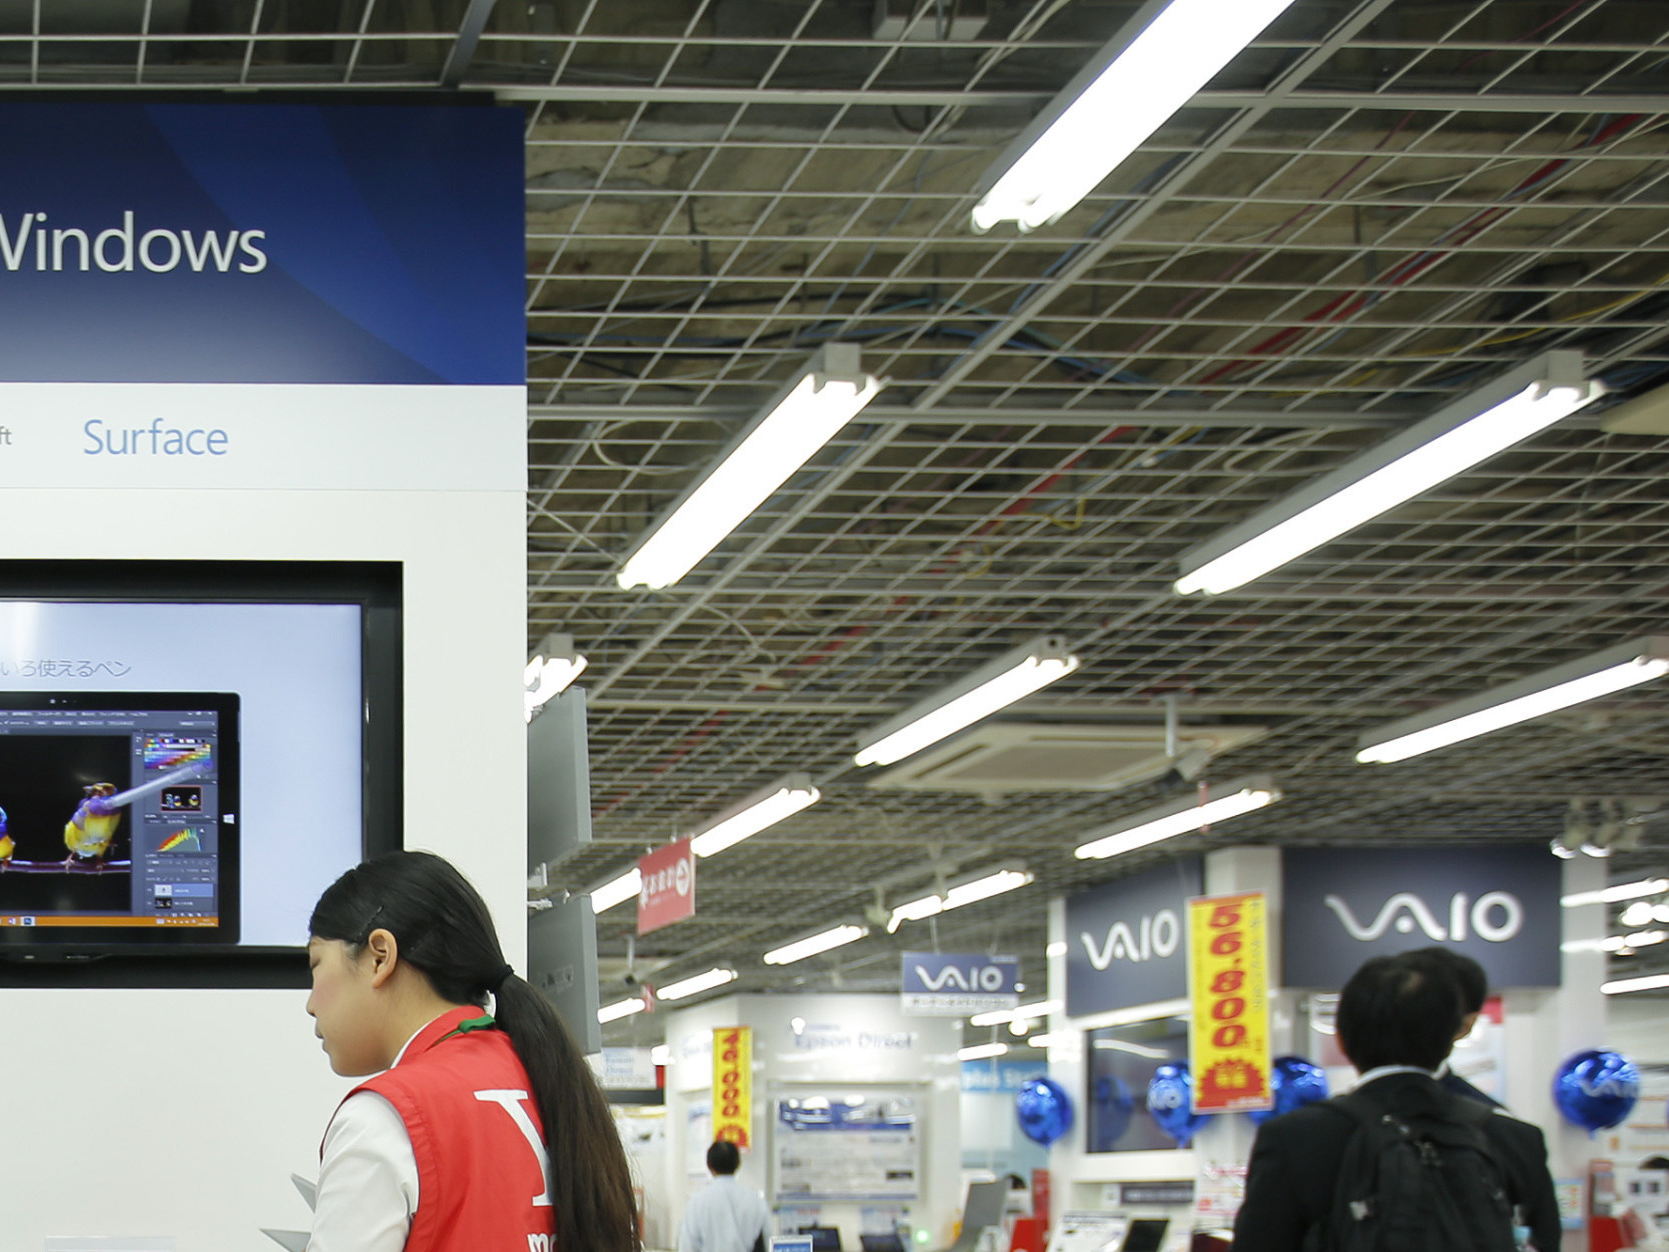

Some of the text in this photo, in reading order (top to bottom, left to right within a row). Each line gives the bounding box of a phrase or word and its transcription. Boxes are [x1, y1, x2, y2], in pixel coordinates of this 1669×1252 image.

[83, 418, 230, 457] Surface
[1325, 890, 1524, 943] VAIO
[1082, 910, 1180, 970] VAIO
[914, 964, 1004, 992] VAIO
